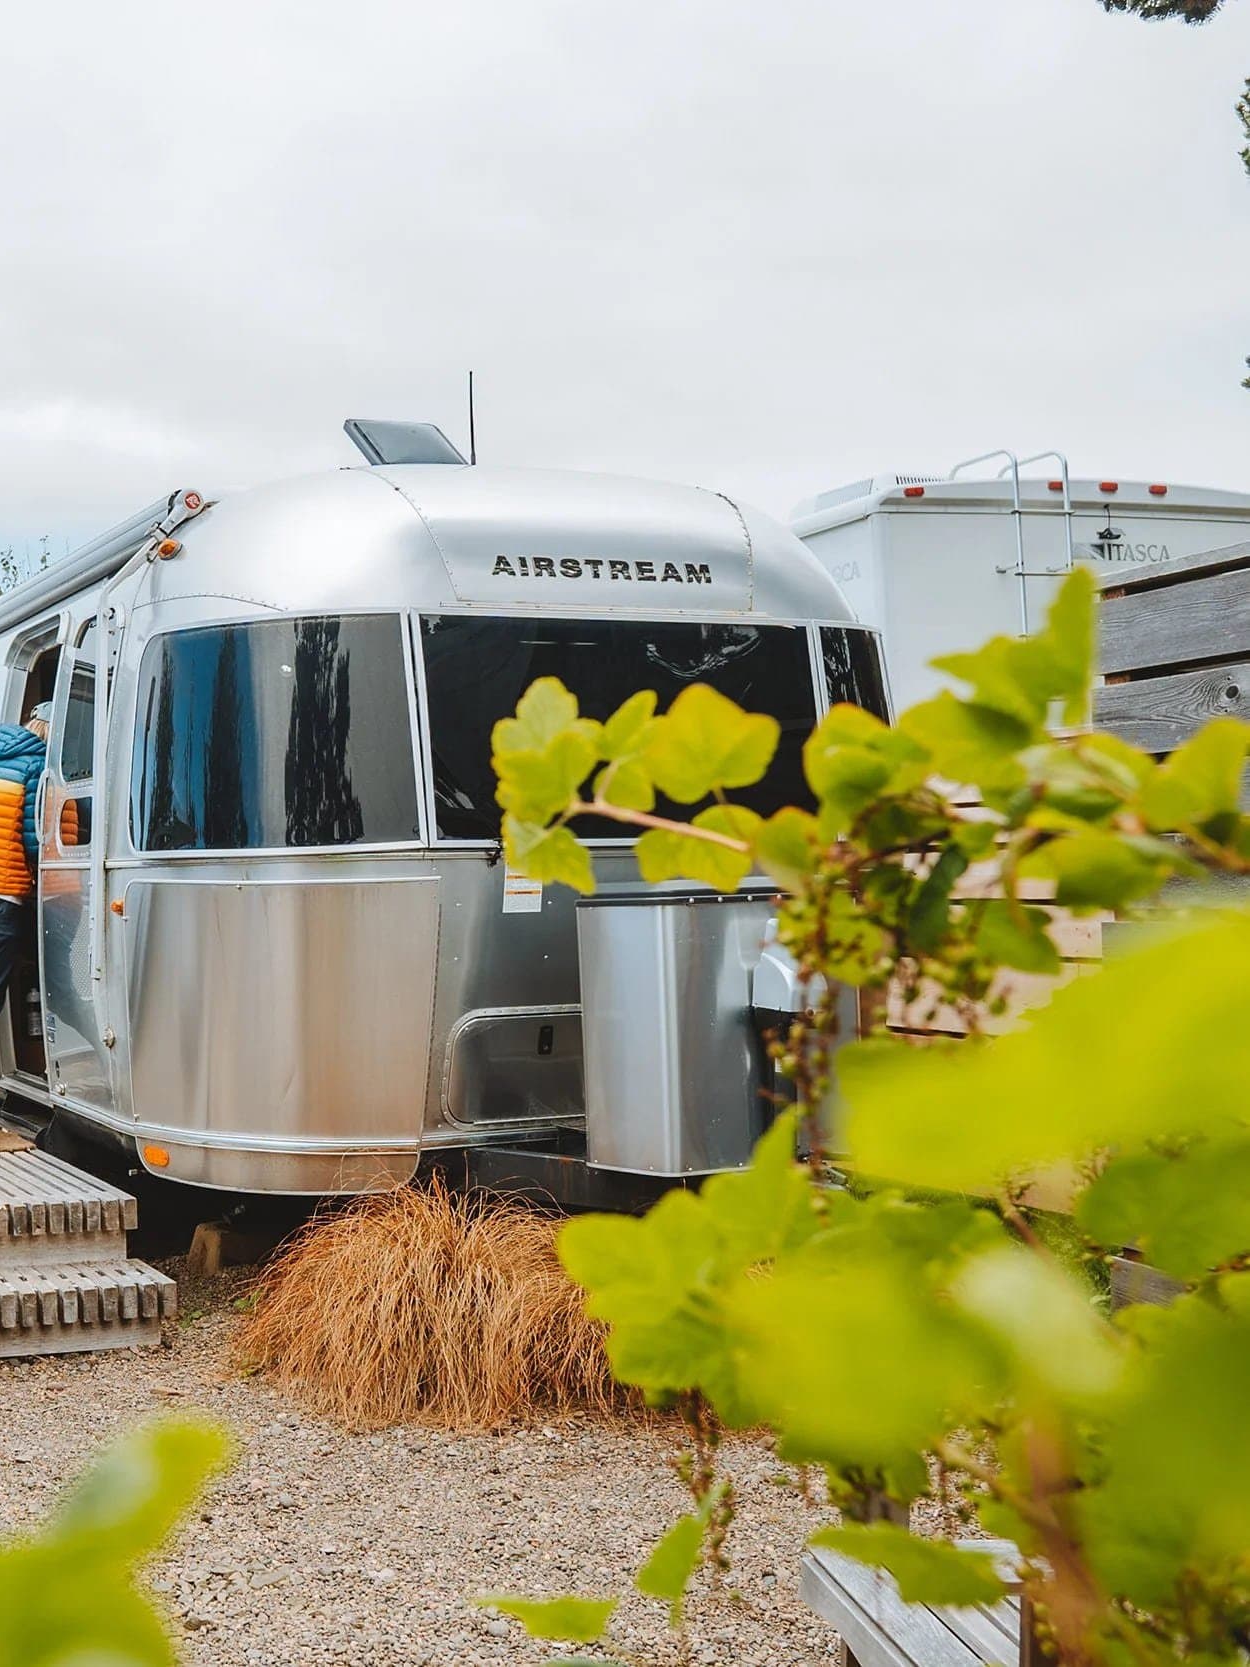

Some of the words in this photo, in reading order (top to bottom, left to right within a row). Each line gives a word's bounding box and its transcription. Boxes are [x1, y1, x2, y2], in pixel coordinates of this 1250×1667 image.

[1107, 543, 1170, 562] ITASCA
[491, 555, 713, 584] AIRSTREAM
[830, 560, 861, 584] SCA
